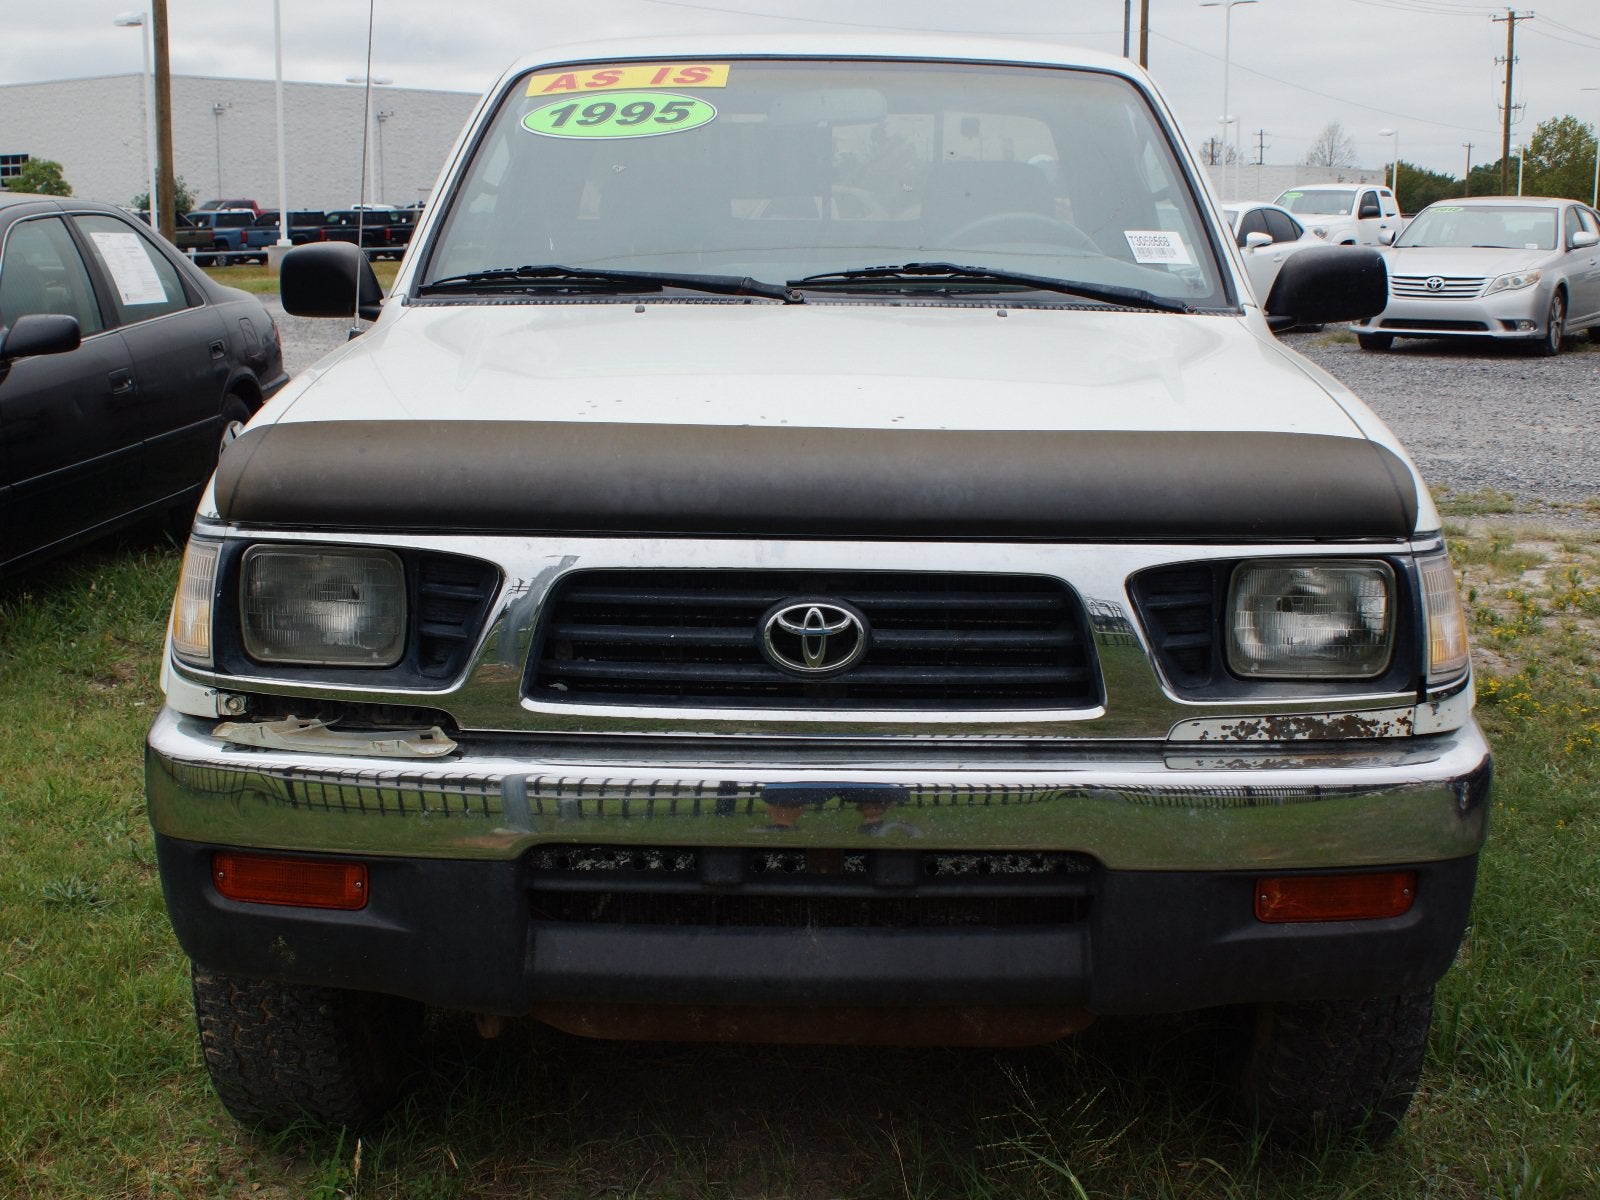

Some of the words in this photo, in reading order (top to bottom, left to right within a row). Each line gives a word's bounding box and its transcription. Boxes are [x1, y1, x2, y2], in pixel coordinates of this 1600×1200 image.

[542, 69, 624, 93] AS
[649, 66, 714, 86] IS
[549, 101, 696, 129] 1995
